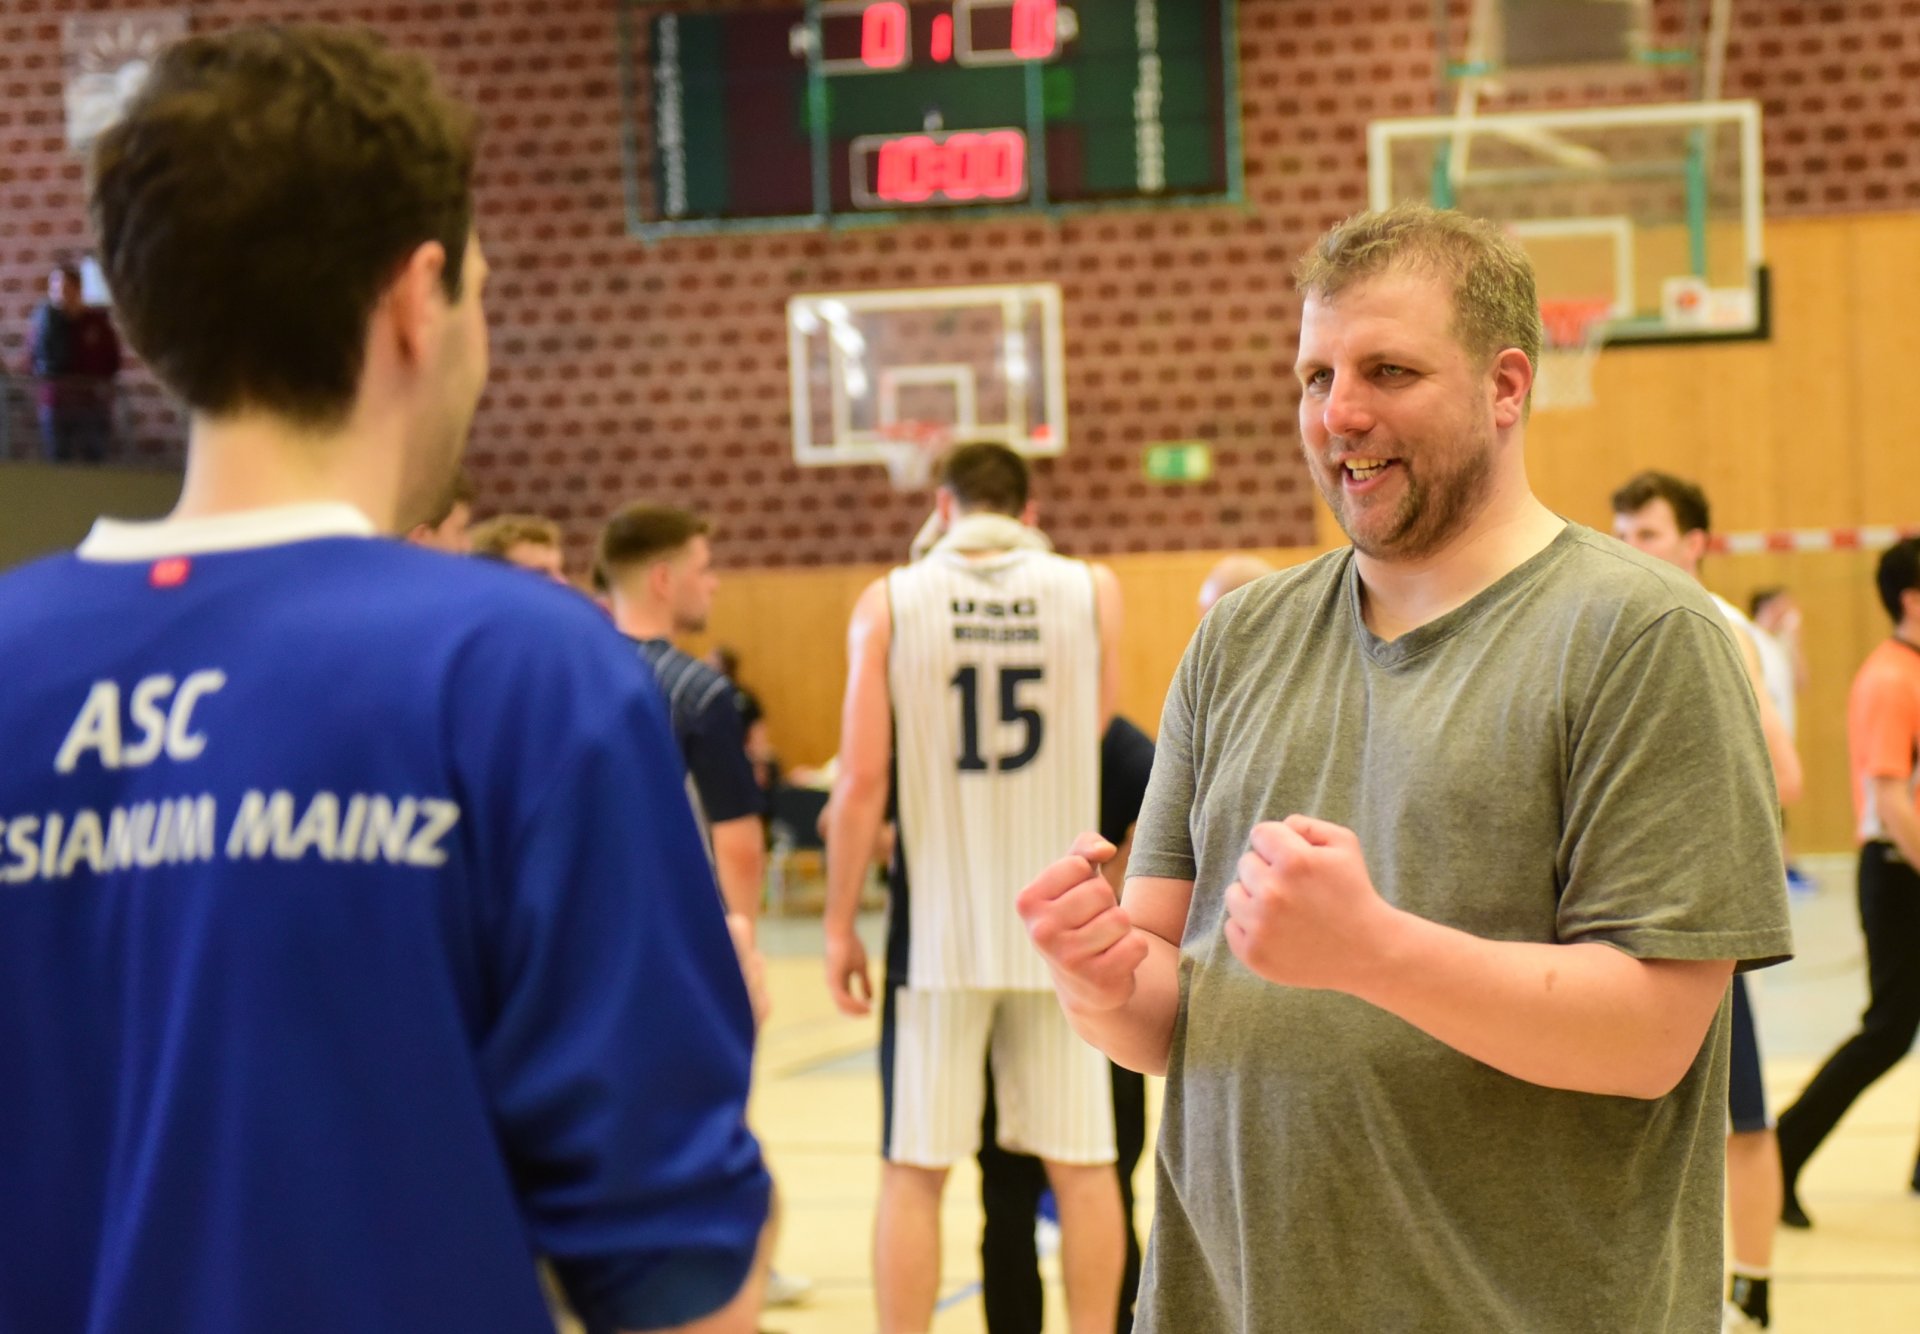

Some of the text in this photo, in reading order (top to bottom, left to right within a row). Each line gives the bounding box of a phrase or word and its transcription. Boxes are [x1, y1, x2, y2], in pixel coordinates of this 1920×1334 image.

[54, 669, 227, 774] ASC
[949, 666, 1043, 771] 15
[0, 789, 460, 882] SIANUM MAINZ
